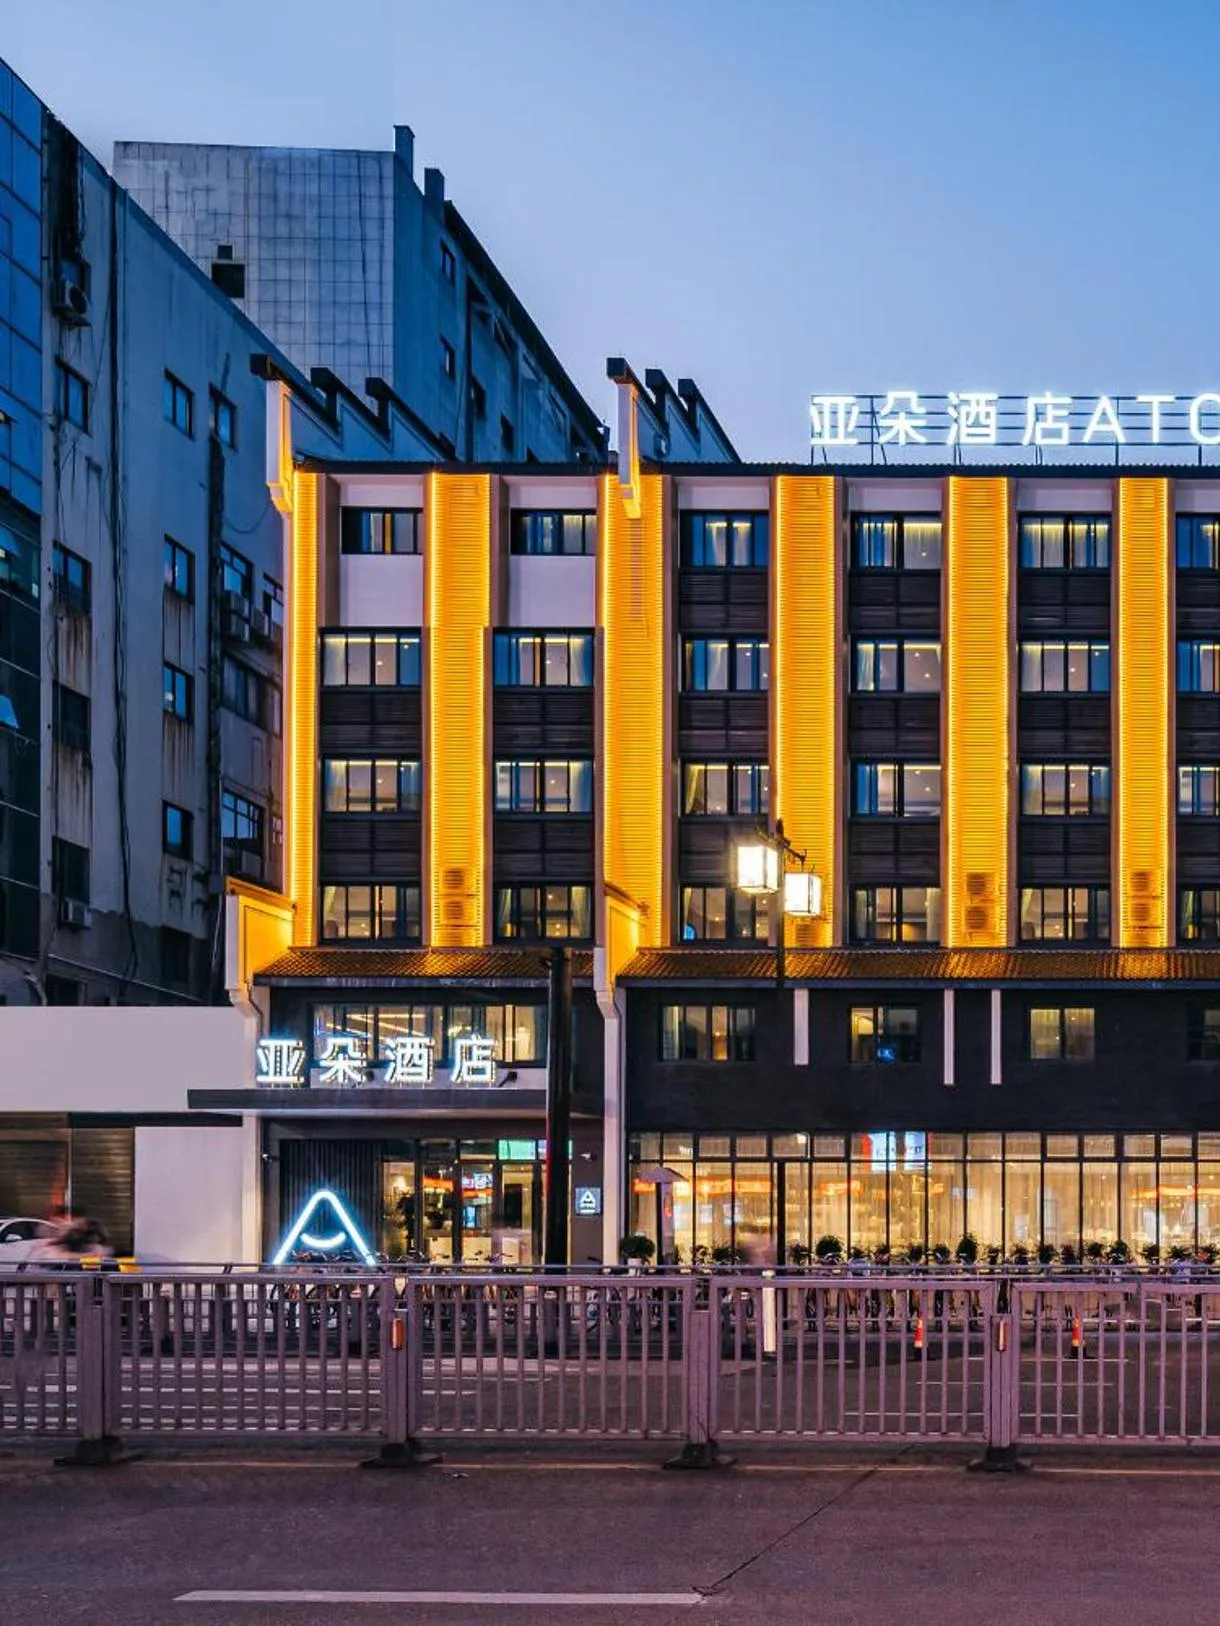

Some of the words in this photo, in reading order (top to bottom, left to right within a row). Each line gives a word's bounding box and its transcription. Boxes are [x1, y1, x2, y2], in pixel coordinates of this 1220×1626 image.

[810, 391, 1073, 446] 亚朵酒店
[256, 1035, 498, 1084] 亚朵酒店
